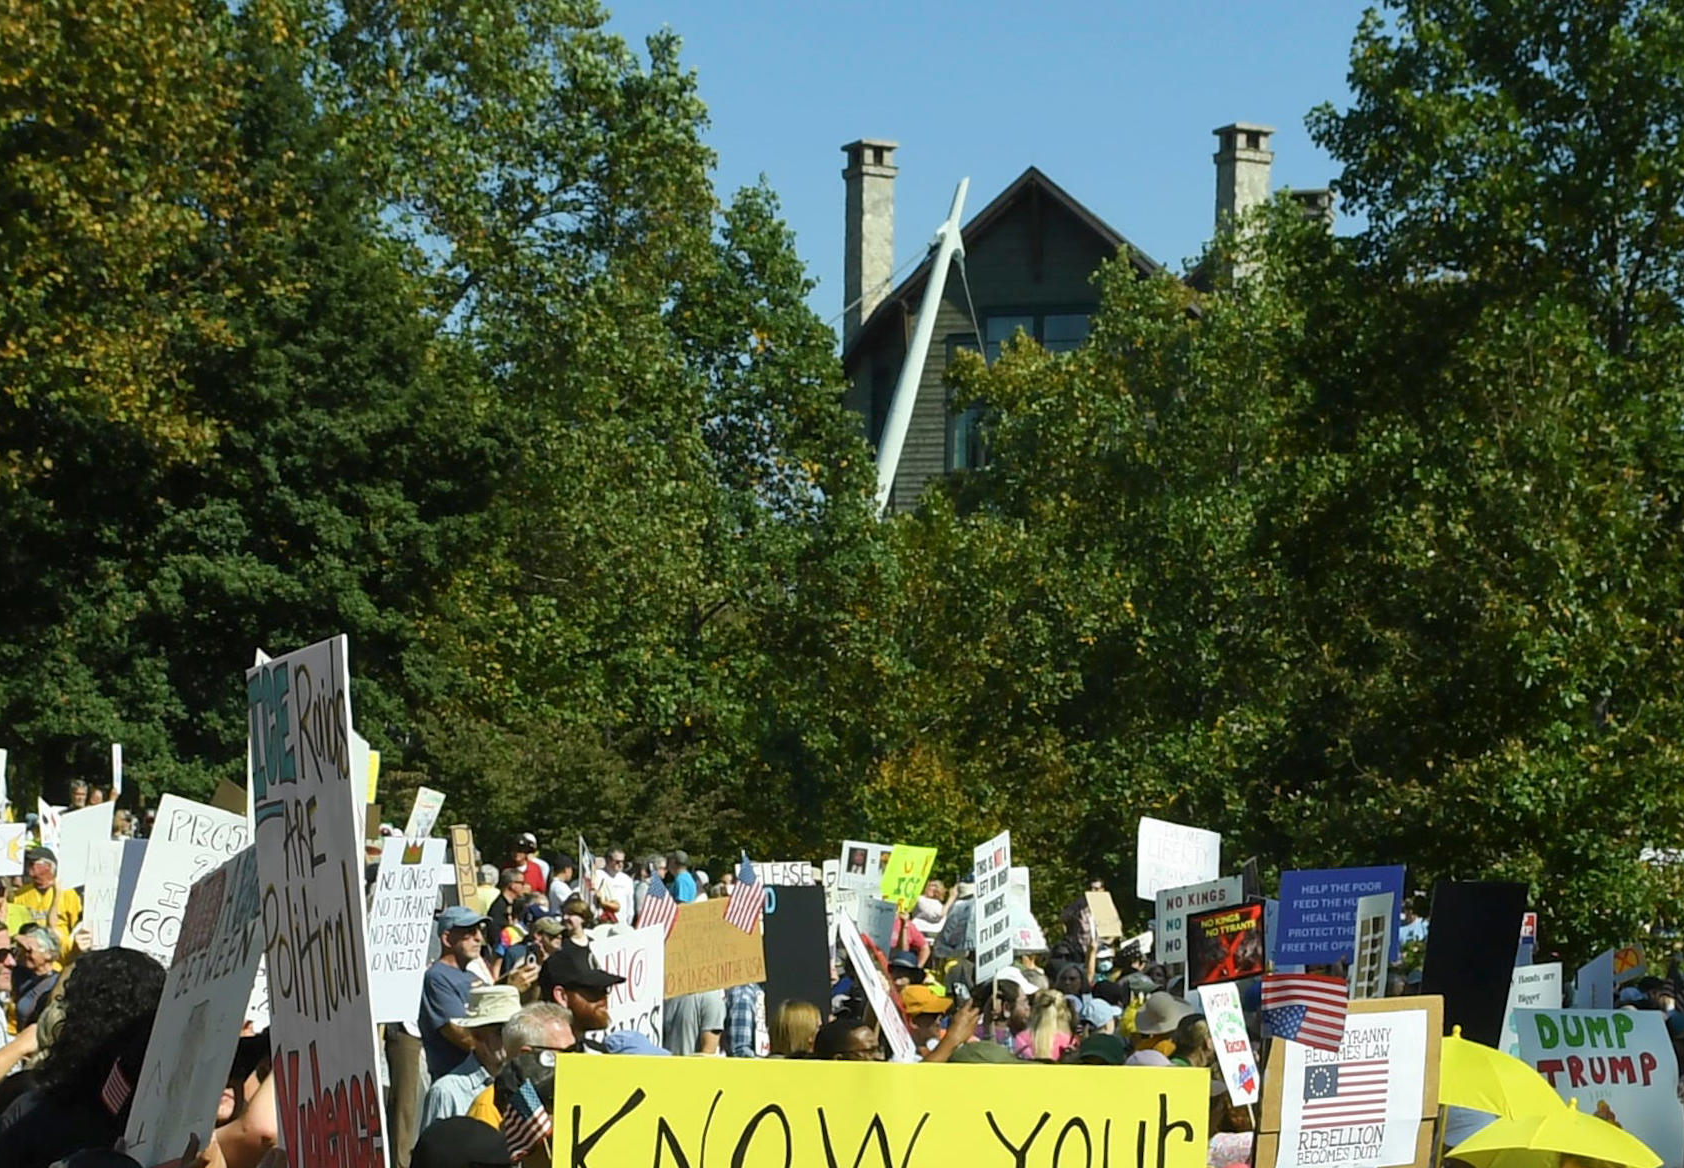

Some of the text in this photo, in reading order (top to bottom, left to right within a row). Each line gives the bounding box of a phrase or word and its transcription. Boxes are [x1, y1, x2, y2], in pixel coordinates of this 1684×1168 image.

[248, 659, 350, 795] ICE Raids
[168, 809, 249, 855] PROJ
[283, 795, 329, 882] ARE
[379, 867, 436, 891] NO KINGS
[757, 862, 811, 887] ELEASE
[976, 877, 989, 899] LEFT
[1301, 881, 1382, 894] HELP THE POOR
[375, 896, 436, 919] NO TYRANTS
[1166, 888, 1227, 911] NO KINGS
[1293, 898, 1342, 909] FEED THE
[1165, 917, 1182, 932] NO
[1201, 913, 1241, 929] NO KINGS
[1205, 919, 1257, 938] NO TYRANTS
[1302, 912, 1351, 923] HEAL THE
[263, 858, 361, 1022] Political
[369, 922, 430, 947] NO FASCISTS
[1288, 926, 1356, 938] PROTECT THE
[1165, 938, 1182, 953] NO
[1281, 941, 1329, 952] FREE THE
[384, 949, 422, 973] NAZIS
[1534, 1012, 1634, 1050] DUMP
[1305, 1043, 1390, 1065] BECOMES LAW
[1536, 1051, 1658, 1089] TRUMP
[1298, 1123, 1385, 1151] REBELLION
[1296, 1149, 1350, 1166] BECOMES
